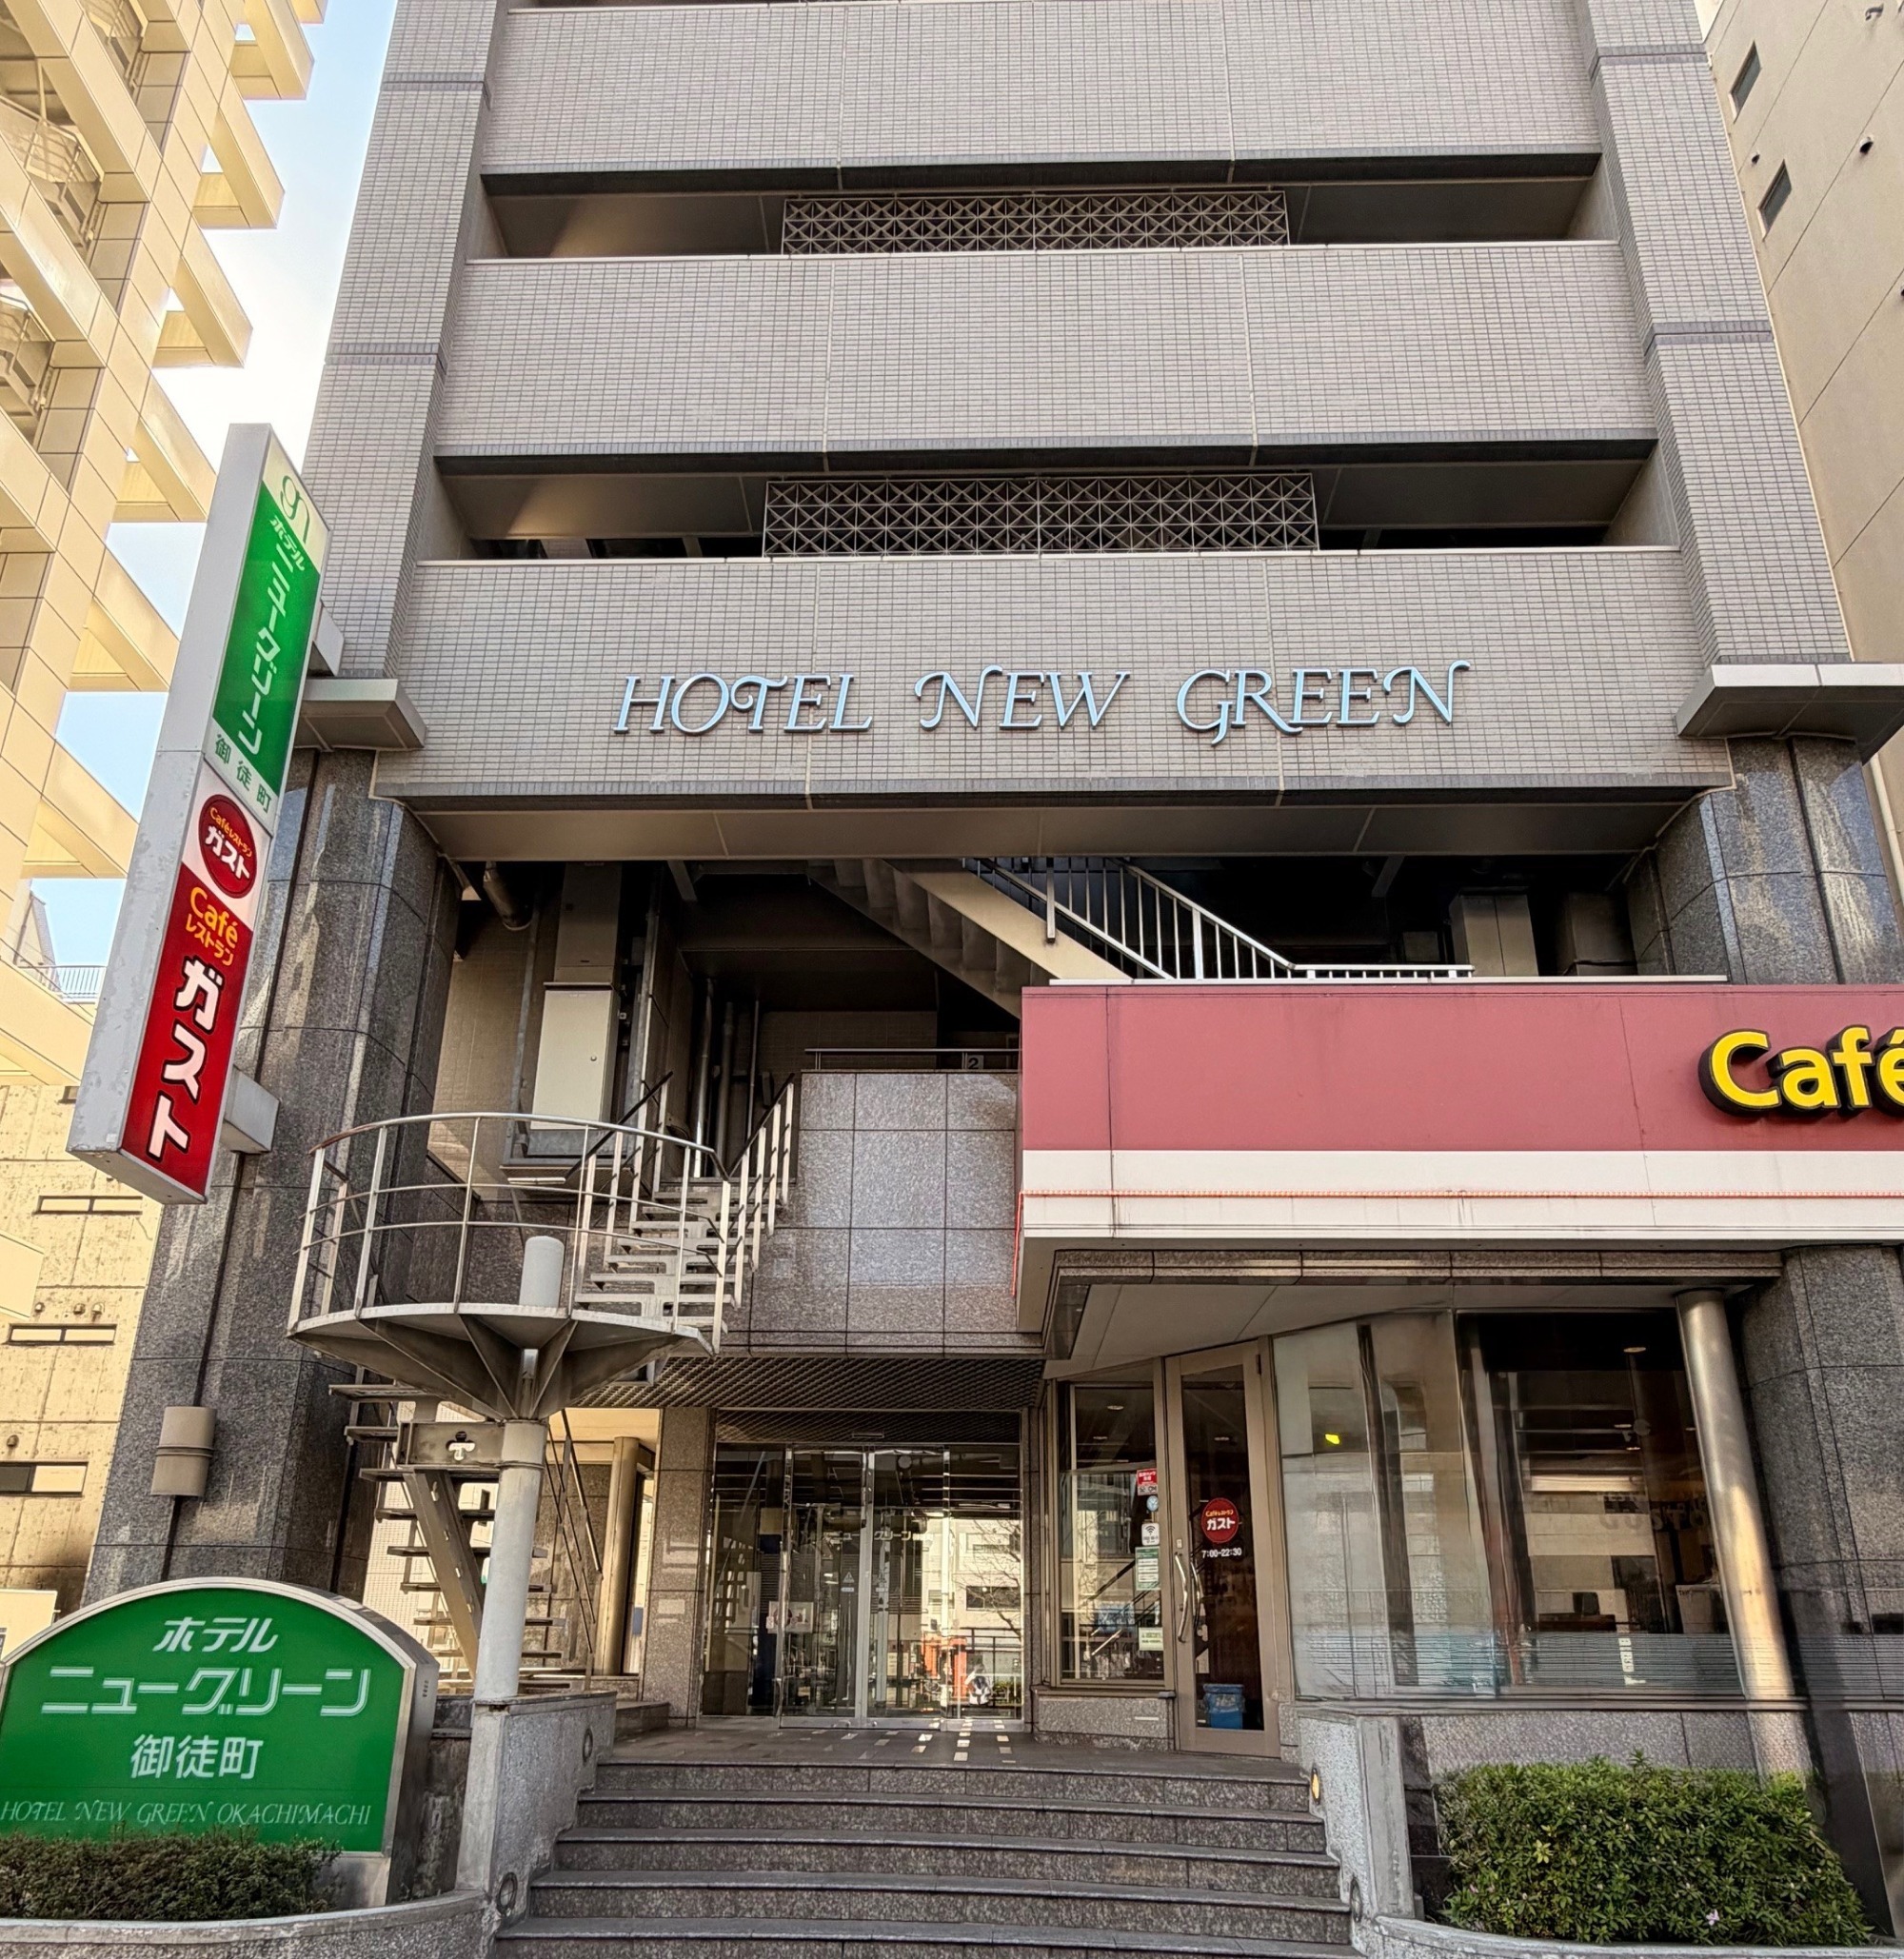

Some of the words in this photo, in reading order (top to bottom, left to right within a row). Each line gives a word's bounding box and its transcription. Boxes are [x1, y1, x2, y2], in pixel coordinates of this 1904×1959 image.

[269, 515, 306, 572] ホテル
[238, 544, 294, 755] ニューグリーン
[613, 672, 873, 735] HOTEL
[914, 664, 1130, 732] NEW
[1175, 660, 1472, 746] GREEN
[213, 734, 272, 813] 御徒町
[205, 825, 250, 880] ガスト
[186, 913, 234, 966] レストラン
[190, 886, 238, 949] Café
[146, 954, 225, 1160] ガスト
[1206, 1517, 1236, 1531] ガスト
[152, 1616, 279, 1652] ホテル
[41, 1666, 371, 1716] ニューグリーン
[130, 1734, 264, 1779] 御徒町
[0, 1801, 67, 1821] HOTEL
[74, 1799, 132, 1821] NEW
[136, 1801, 214, 1827] GREEN
[217, 1802, 371, 1826] OKACHIMACHI
